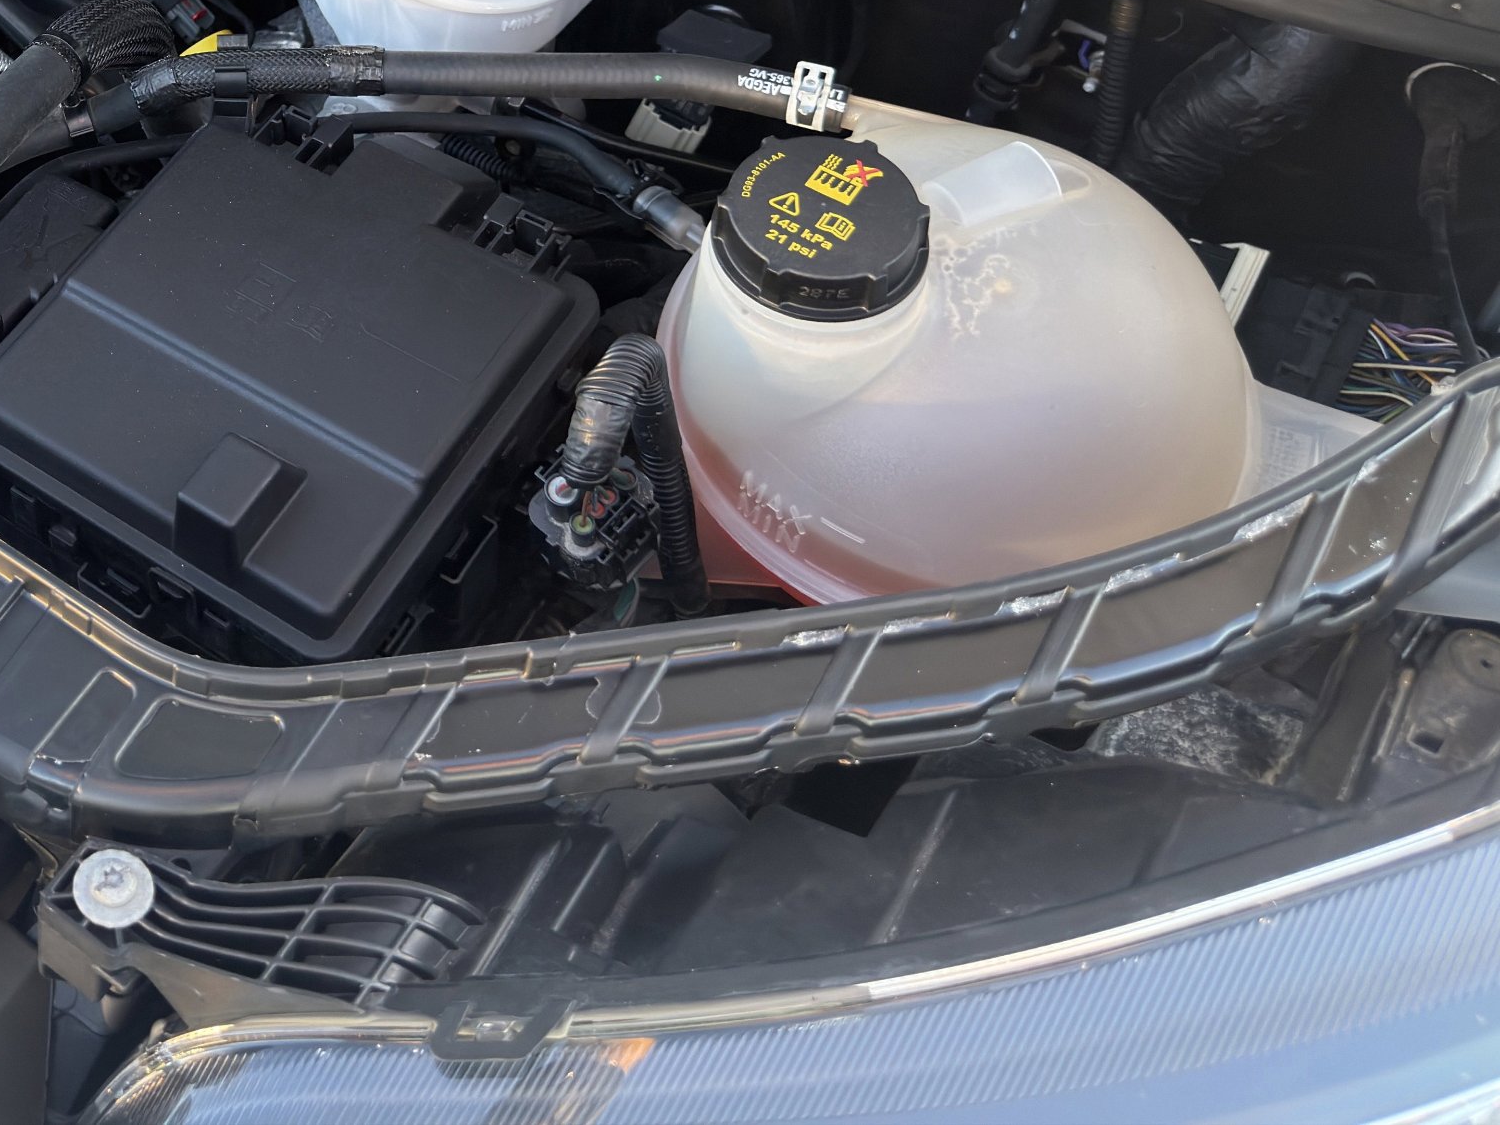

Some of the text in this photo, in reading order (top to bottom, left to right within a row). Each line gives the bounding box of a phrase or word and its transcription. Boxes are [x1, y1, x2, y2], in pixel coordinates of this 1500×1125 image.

[737, 74, 780, 96] AEGDA
[764, 229, 818, 259] 21 psi
[769, 214, 834, 251] 145 kPa
[739, 470, 813, 535] MAX
